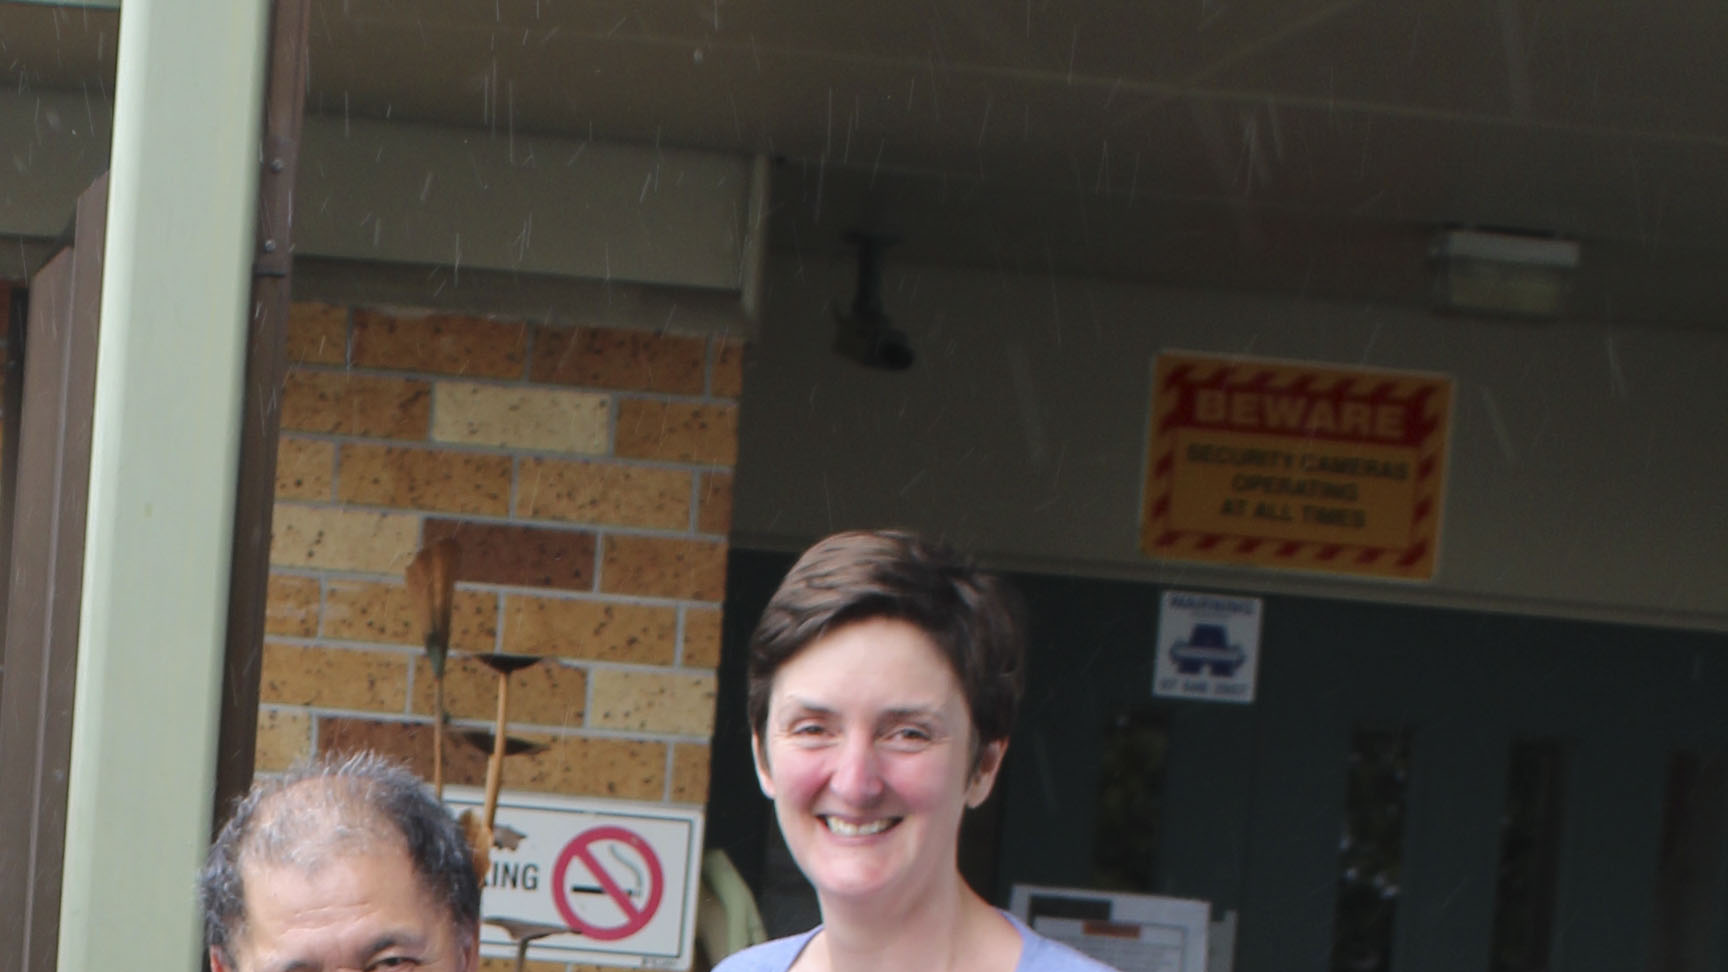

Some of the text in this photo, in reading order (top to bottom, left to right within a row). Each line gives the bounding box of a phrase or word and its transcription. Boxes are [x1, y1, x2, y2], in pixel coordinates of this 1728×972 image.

[1195, 387, 1405, 438] BEWARE
[1187, 442, 1410, 482] SECURITY CAMERAS
[1232, 472, 1359, 503] OPERATING
[1219, 497, 1367, 529] AT ALL TIMES
[485, 860, 540, 891] ING
